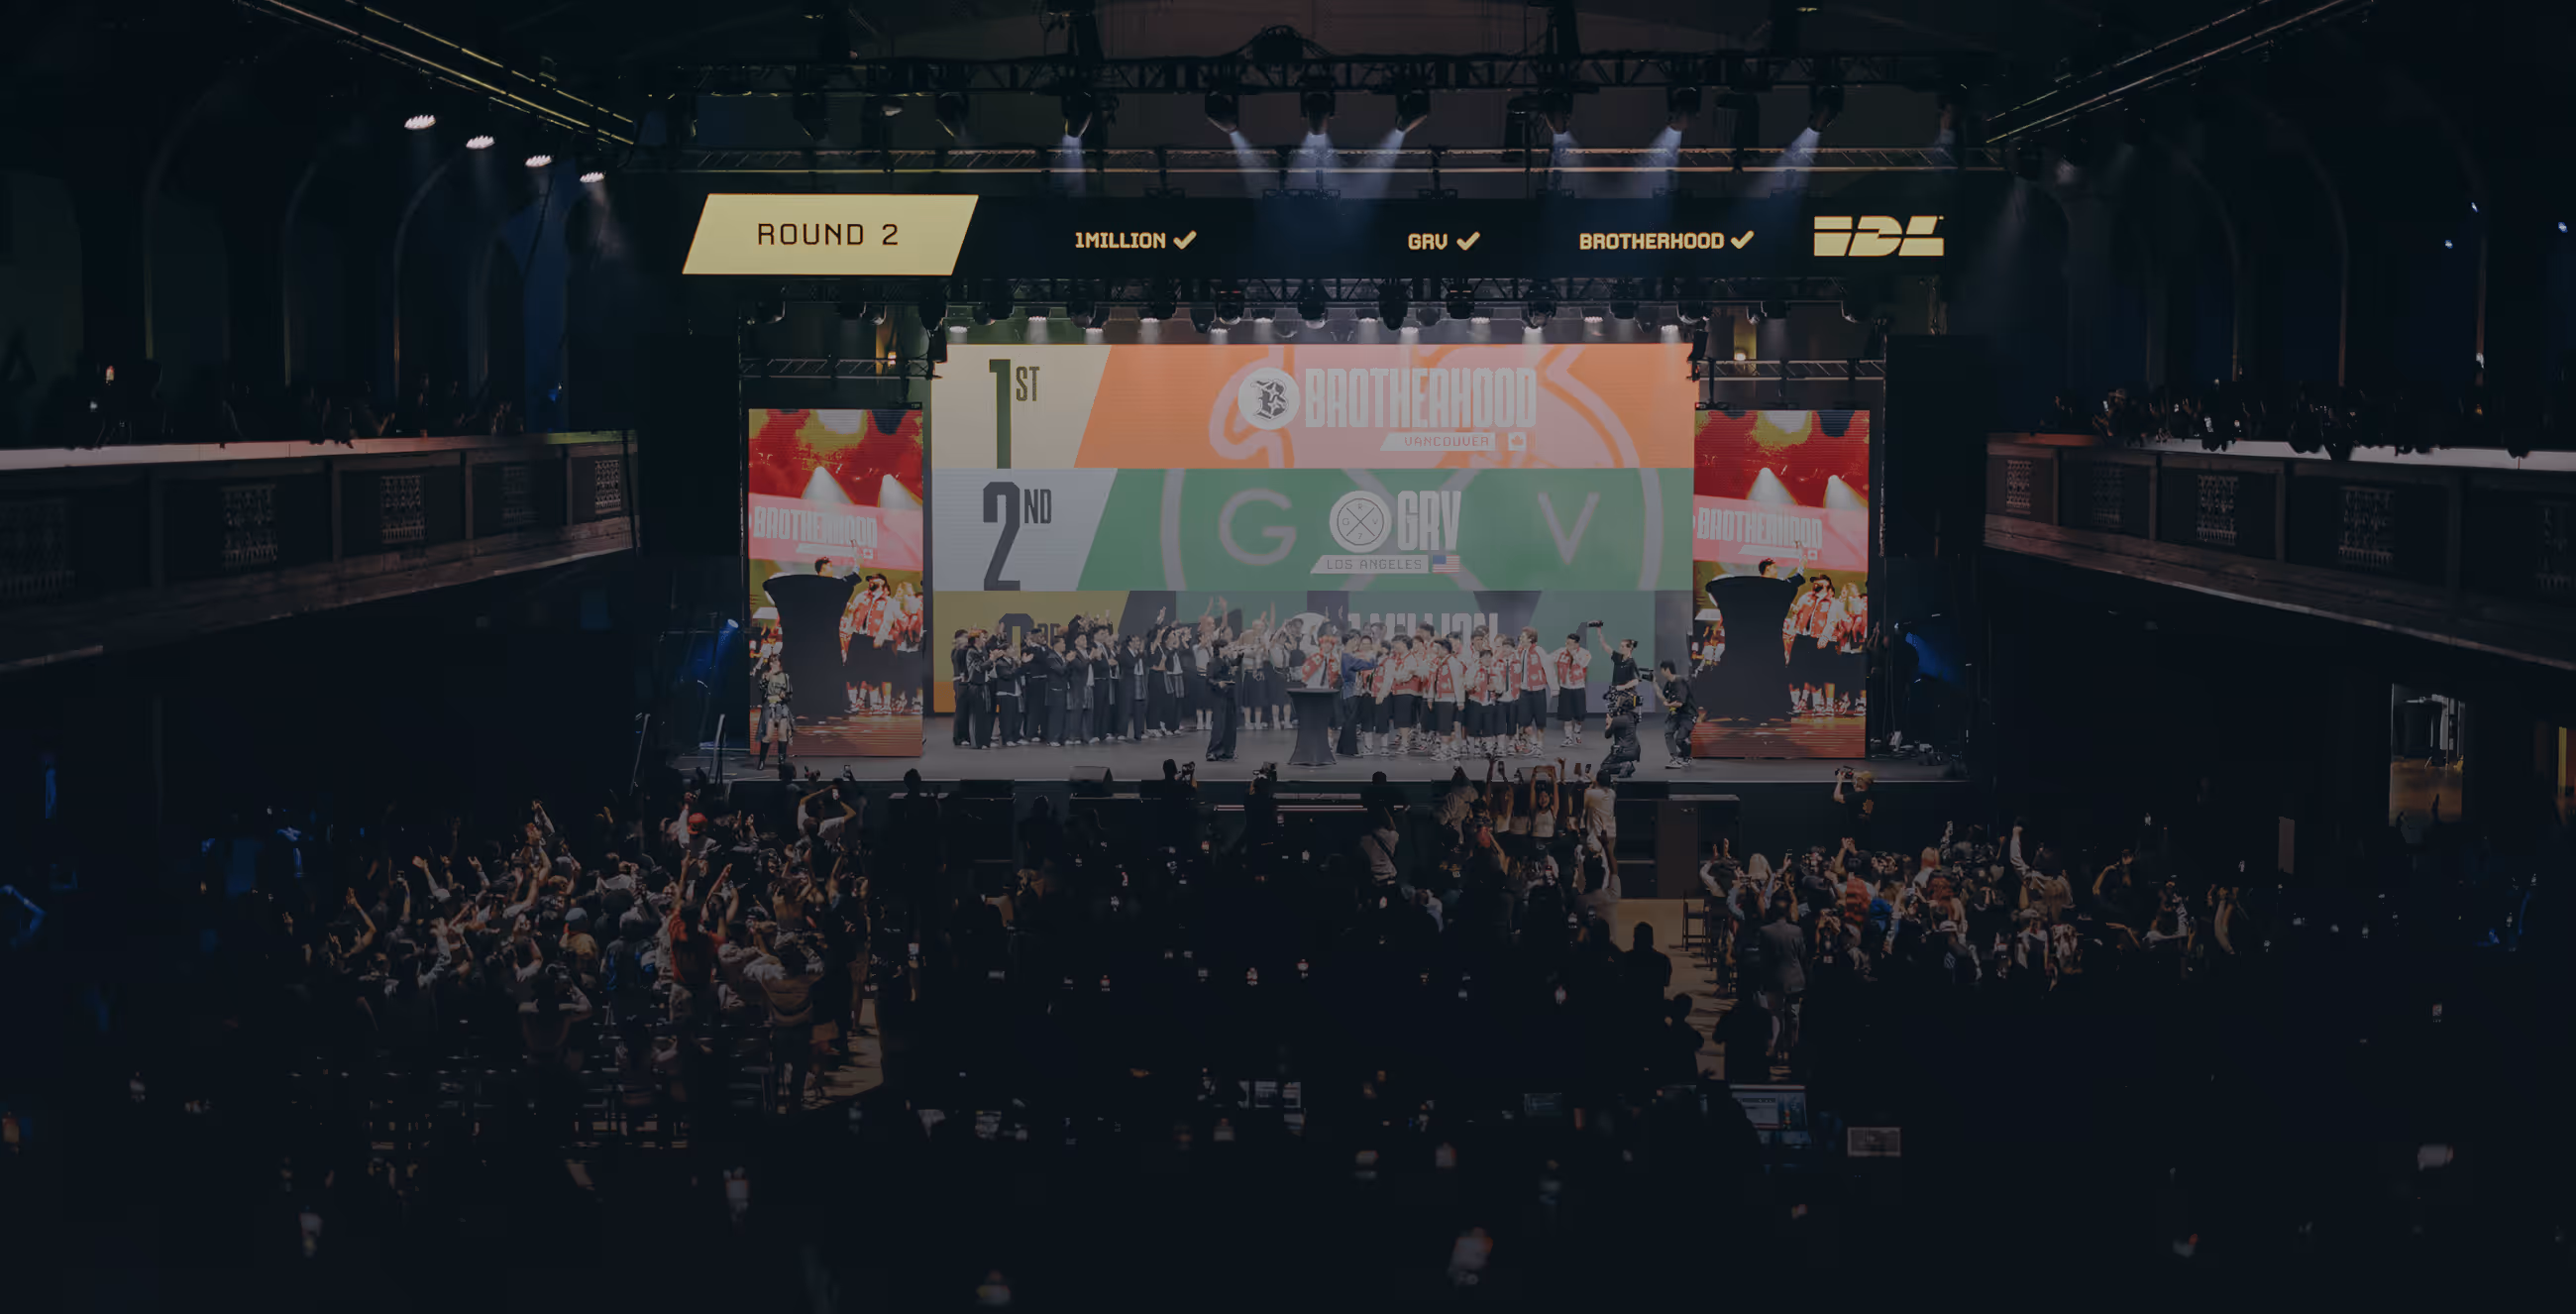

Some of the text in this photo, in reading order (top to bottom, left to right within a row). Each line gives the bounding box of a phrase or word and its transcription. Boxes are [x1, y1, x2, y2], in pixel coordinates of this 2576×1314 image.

[758, 223, 899, 246] ROUND 2
[1075, 231, 1166, 249] 1MILLION
[1408, 233, 1448, 250] GRV
[1579, 232, 1725, 250] BROTHERHOOD
[1305, 367, 1537, 428] BROTHERHOOD
[989, 359, 1040, 469] 1ST
[1404, 435, 1489, 447] VANCOUVER
[1397, 490, 1462, 551] GRV
[983, 482, 1052, 592] 2ND
[1327, 559, 1423, 570] LOS ANGELES
